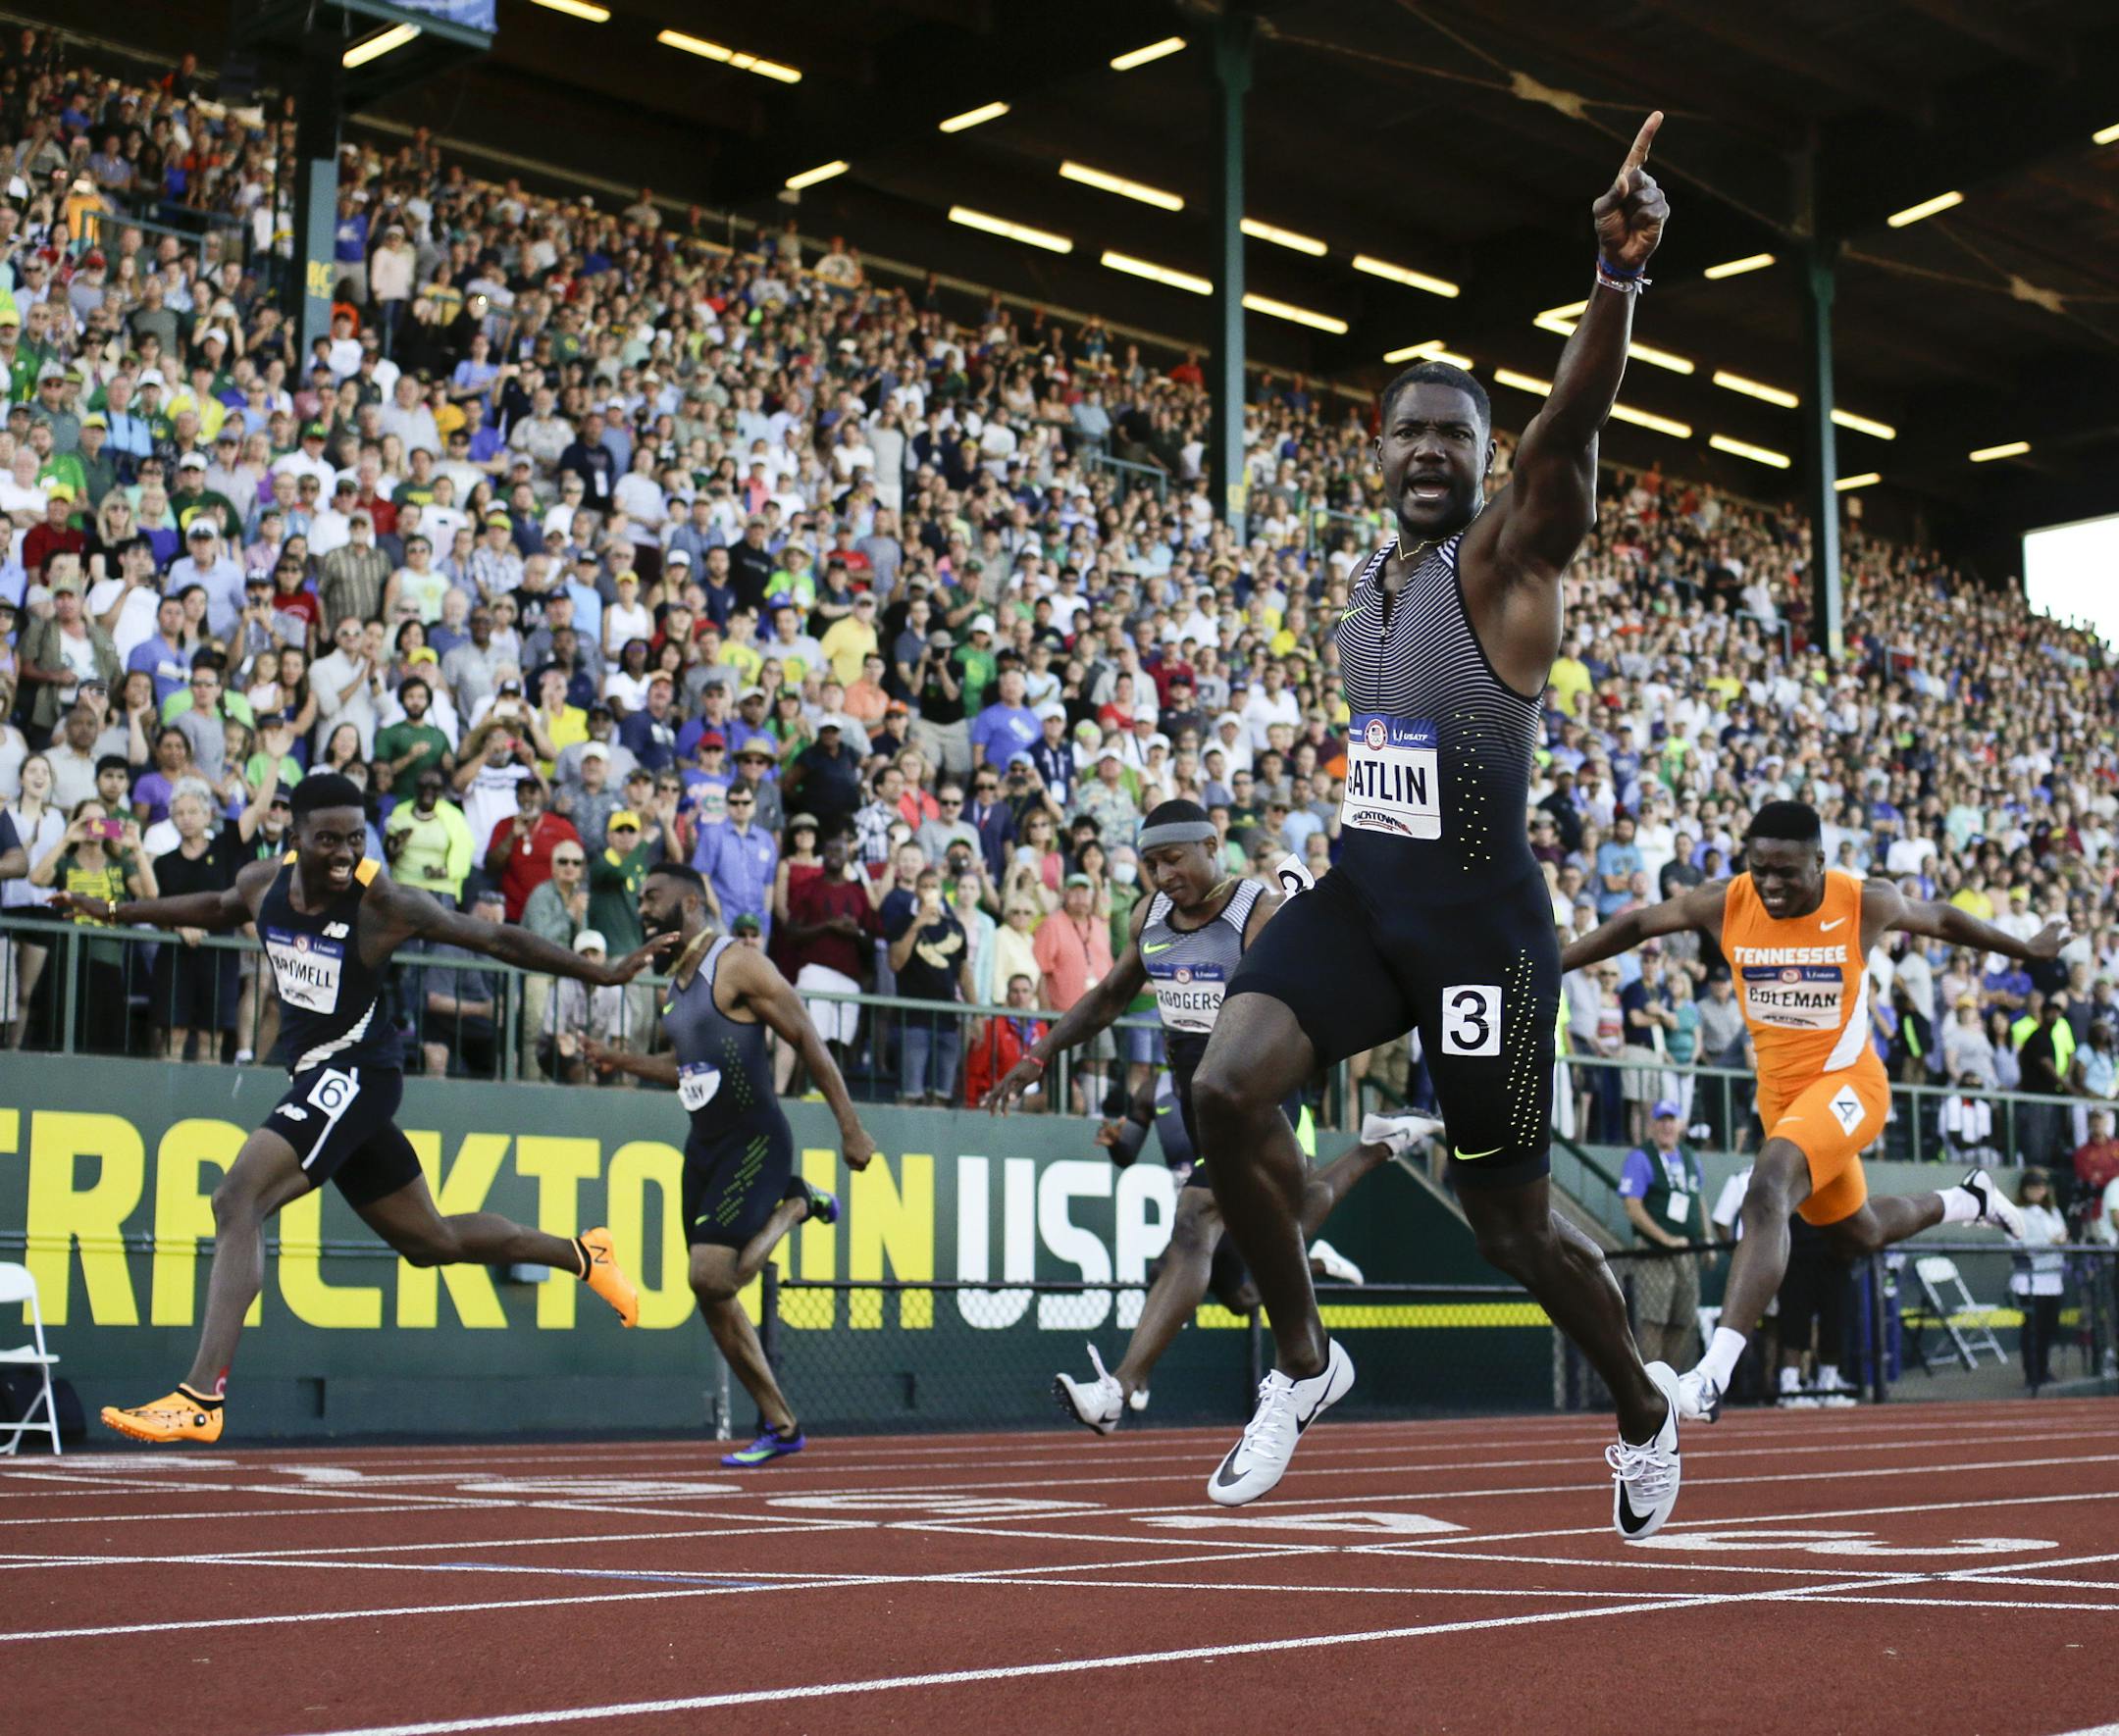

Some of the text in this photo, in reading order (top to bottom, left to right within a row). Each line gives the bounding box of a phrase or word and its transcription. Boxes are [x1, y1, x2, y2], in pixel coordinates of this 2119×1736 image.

[1732, 945, 1847, 965] TENNESSEE
[1158, 989, 1222, 1011] RODGERS
[1749, 987, 1837, 1009] COLEMAN
[1450, 991, 1489, 1050] 3
[319, 1078, 349, 1108] 6
[1836, 1100, 1859, 1124] 4
[0, 1108, 1188, 1330] RACKTON USA
[1624, 1529, 2060, 1557] 3
